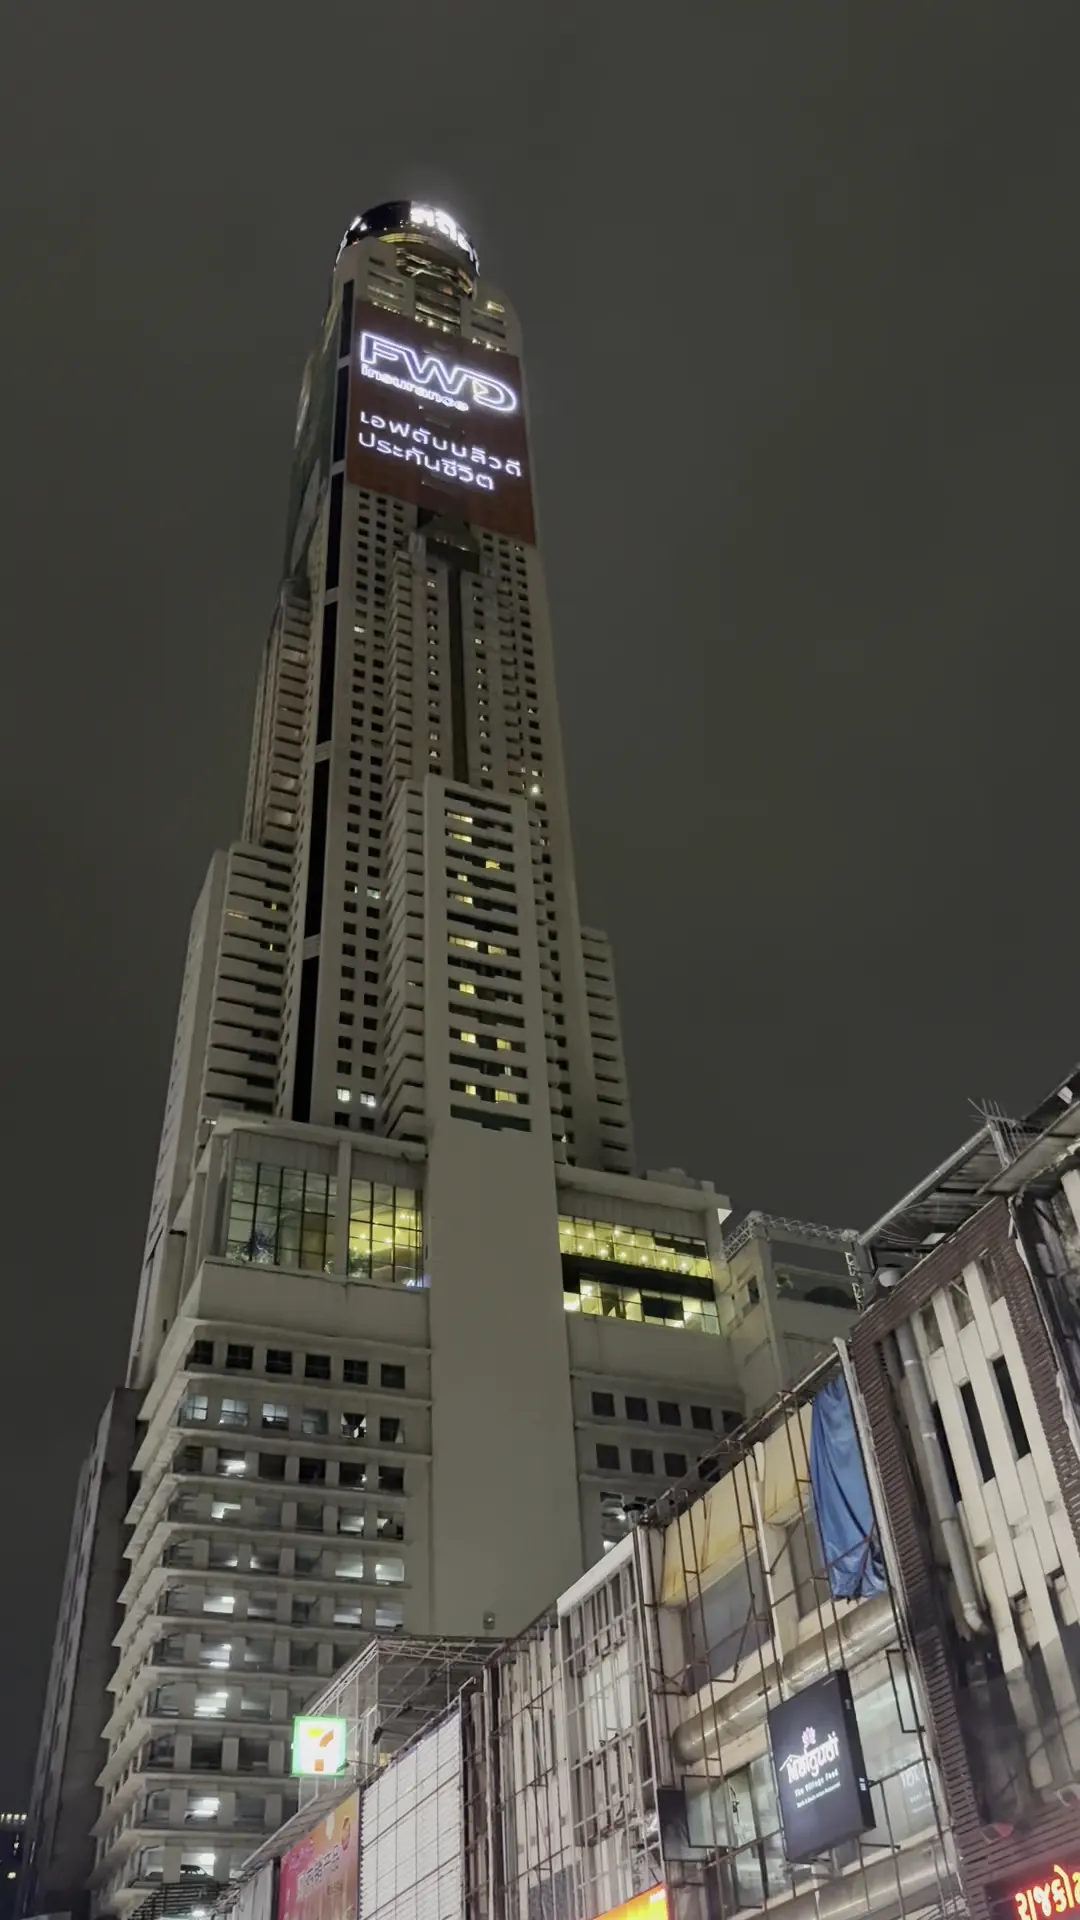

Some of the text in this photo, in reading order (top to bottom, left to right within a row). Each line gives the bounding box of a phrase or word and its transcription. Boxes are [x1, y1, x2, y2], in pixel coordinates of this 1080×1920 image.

[360, 331, 518, 411] FWD
[358, 431, 495, 490] ประกันชีวิต
